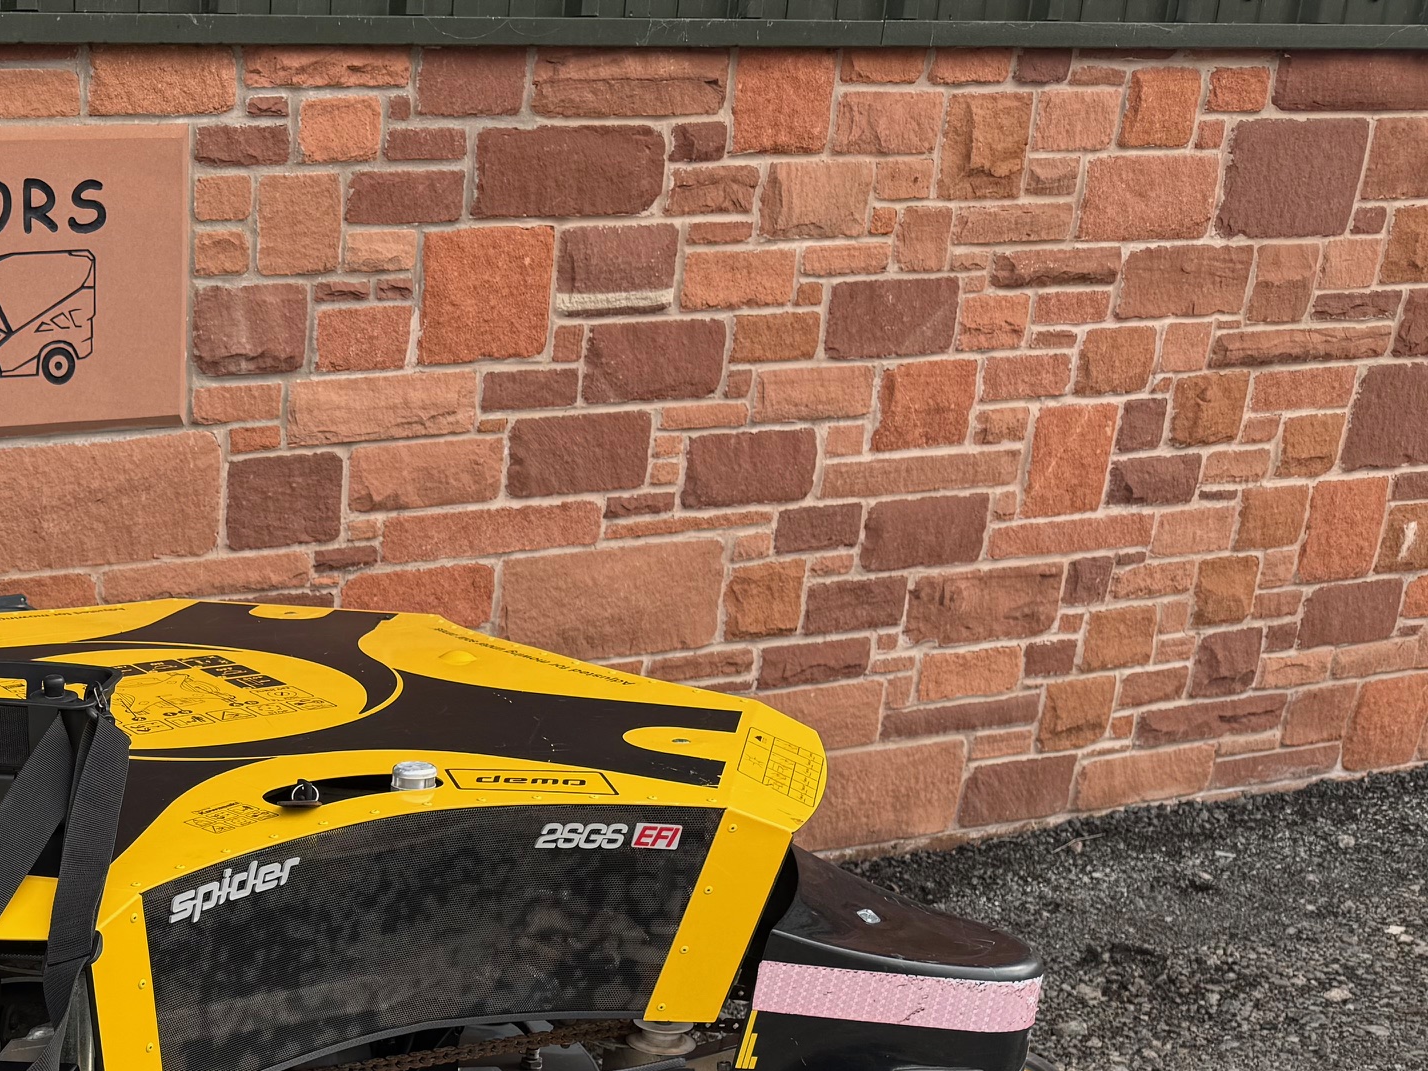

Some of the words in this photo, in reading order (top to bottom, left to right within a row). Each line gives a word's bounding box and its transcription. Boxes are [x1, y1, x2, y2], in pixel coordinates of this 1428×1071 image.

[476, 774, 587, 787] demo
[534, 822, 629, 850] 2SGS
[632, 823, 682, 849] EFI
[169, 856, 301, 924] spider
